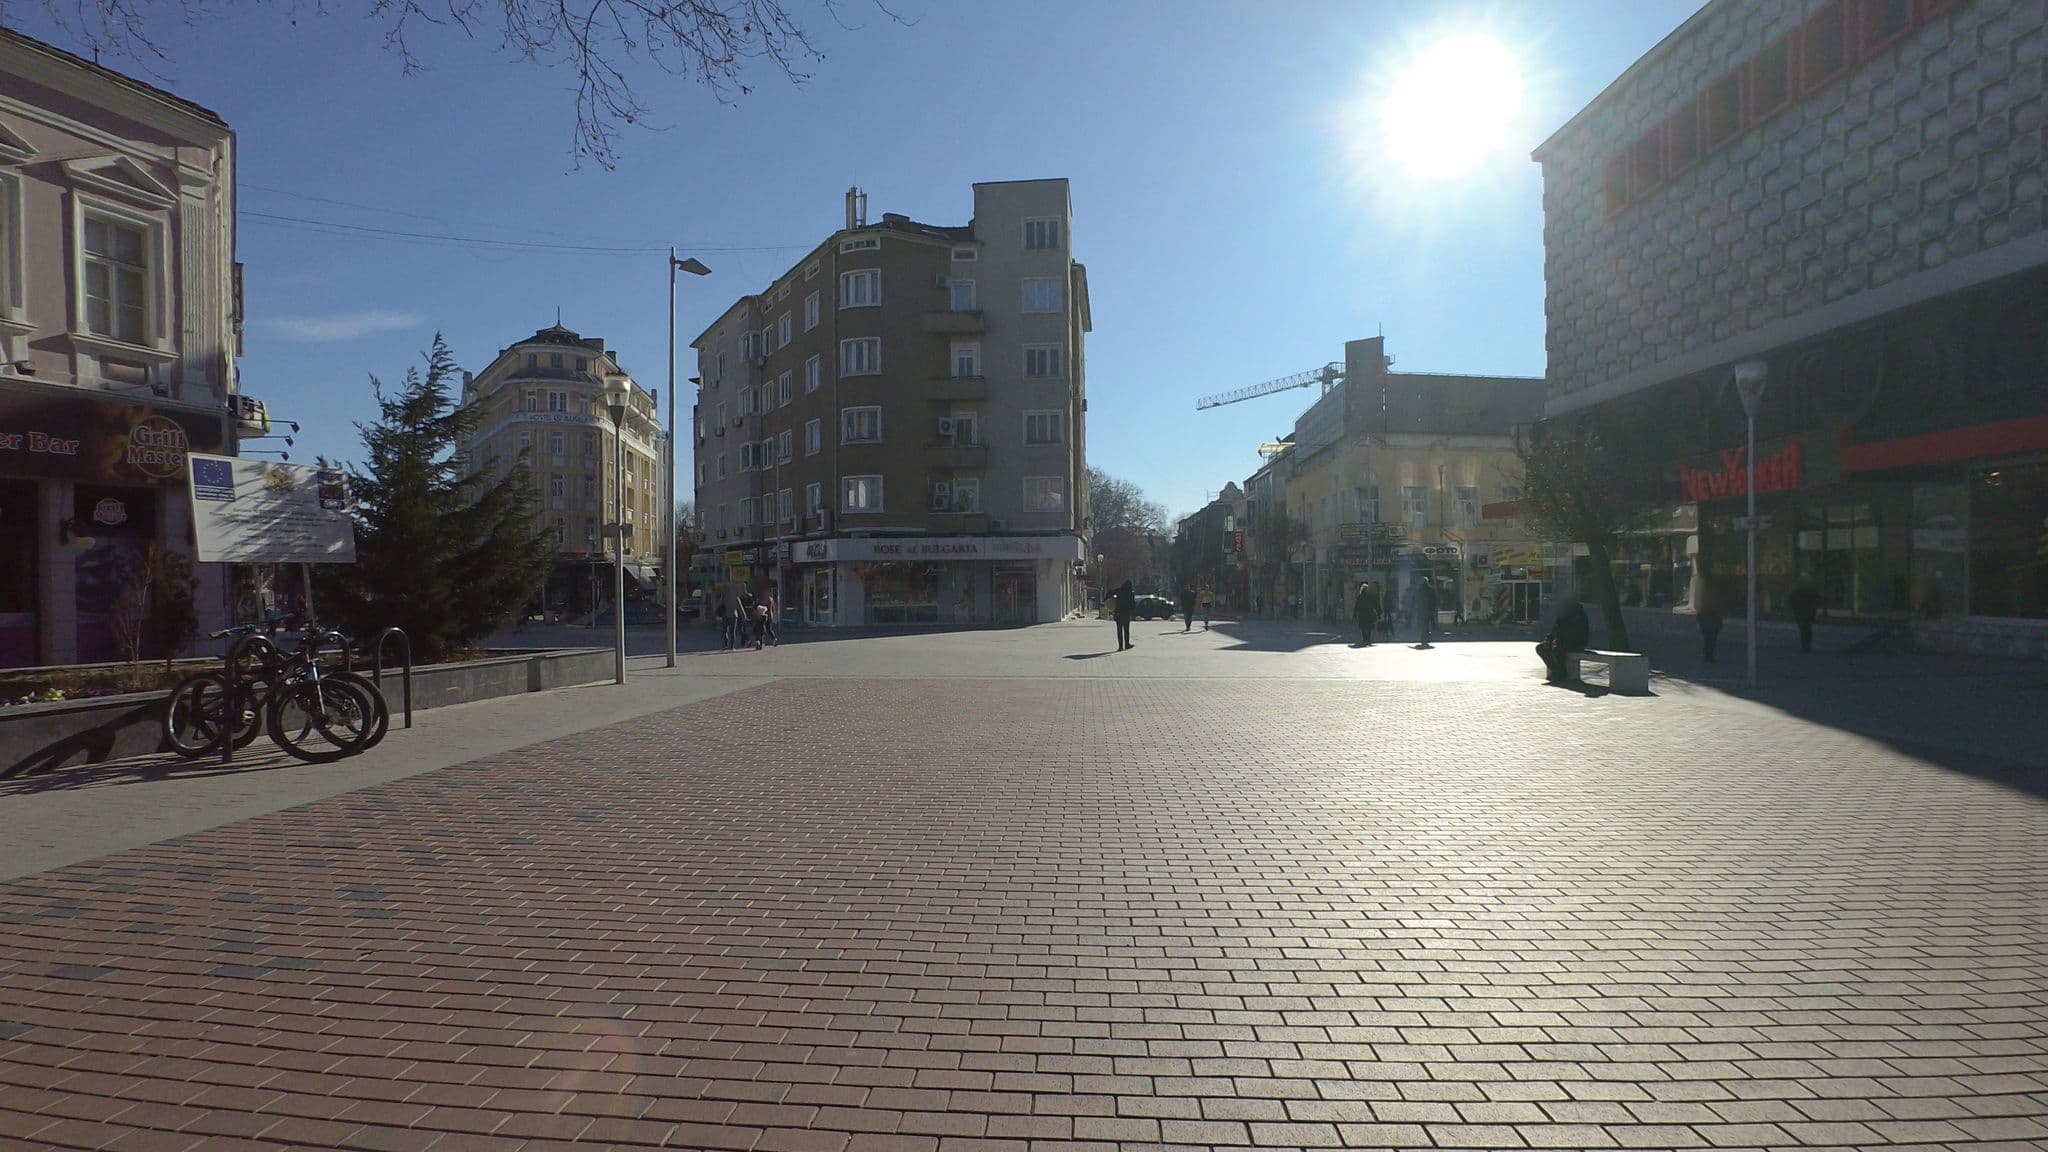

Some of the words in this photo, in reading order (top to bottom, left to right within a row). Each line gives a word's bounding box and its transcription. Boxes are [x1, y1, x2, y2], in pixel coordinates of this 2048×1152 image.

[28, 431, 81, 455] Bar
[134, 425, 186, 449] Grill
[872, 543, 901, 554] ROSE
[921, 543, 978, 554] BULGARIA
